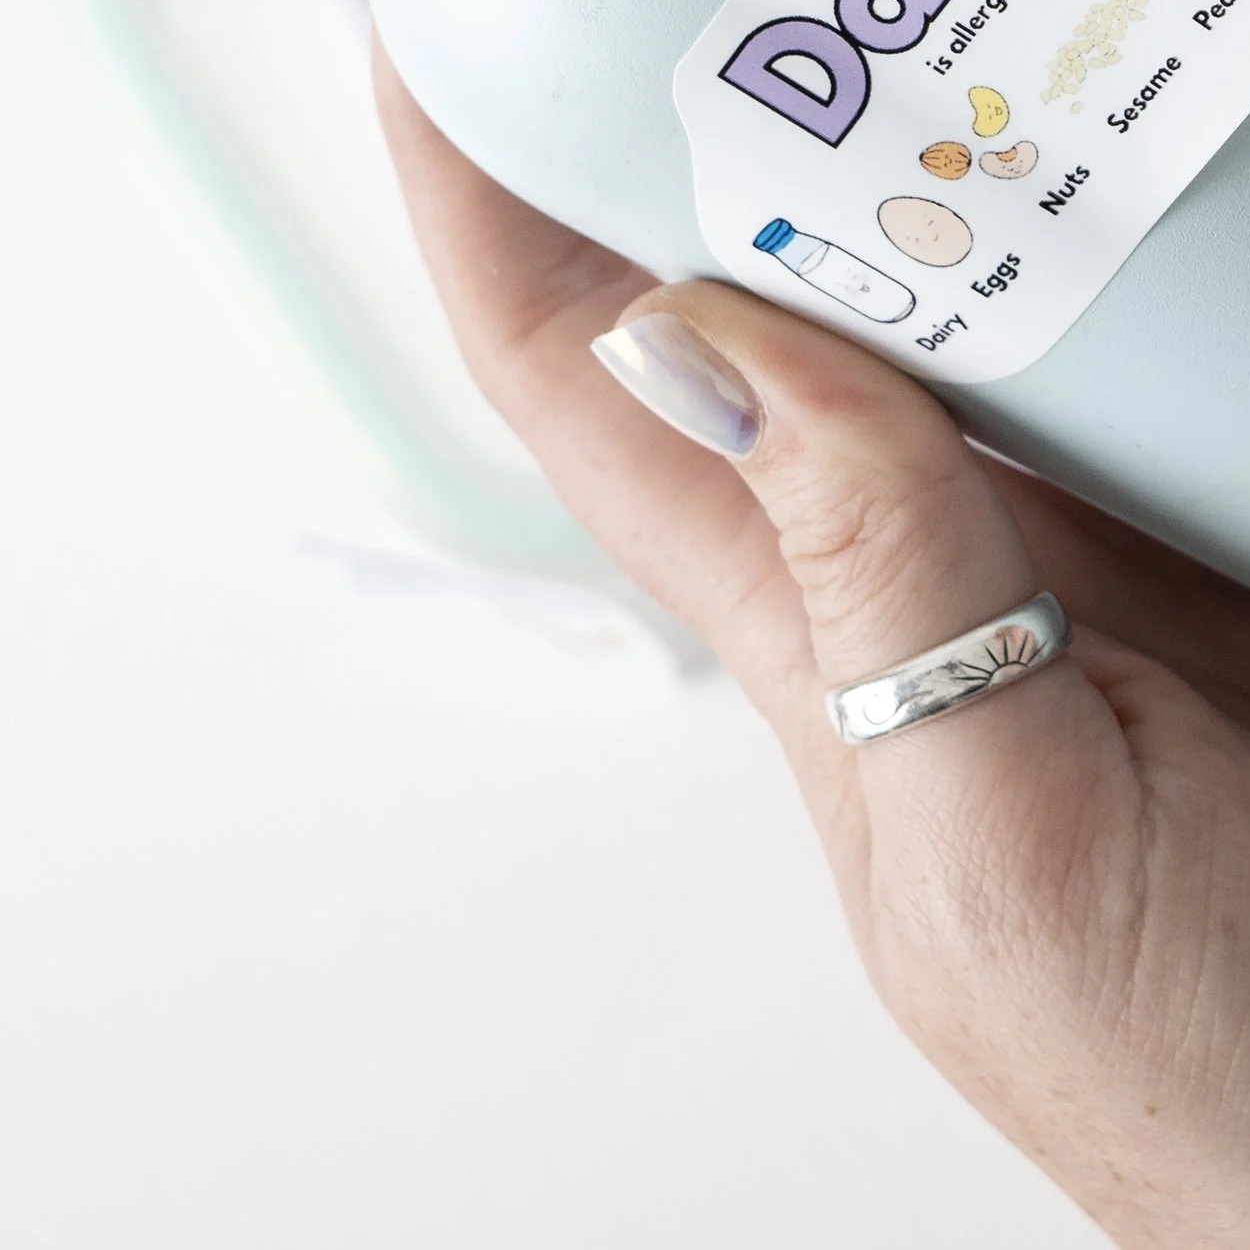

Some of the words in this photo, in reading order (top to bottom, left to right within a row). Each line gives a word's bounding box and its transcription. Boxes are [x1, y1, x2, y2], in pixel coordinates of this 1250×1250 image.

[925, 56, 953, 75] is
[1108, 57, 1181, 133] Sesame
[1039, 165, 1091, 215] Nuts
[971, 253, 1020, 298] Eggs
[916, 313, 968, 351] Dairy
